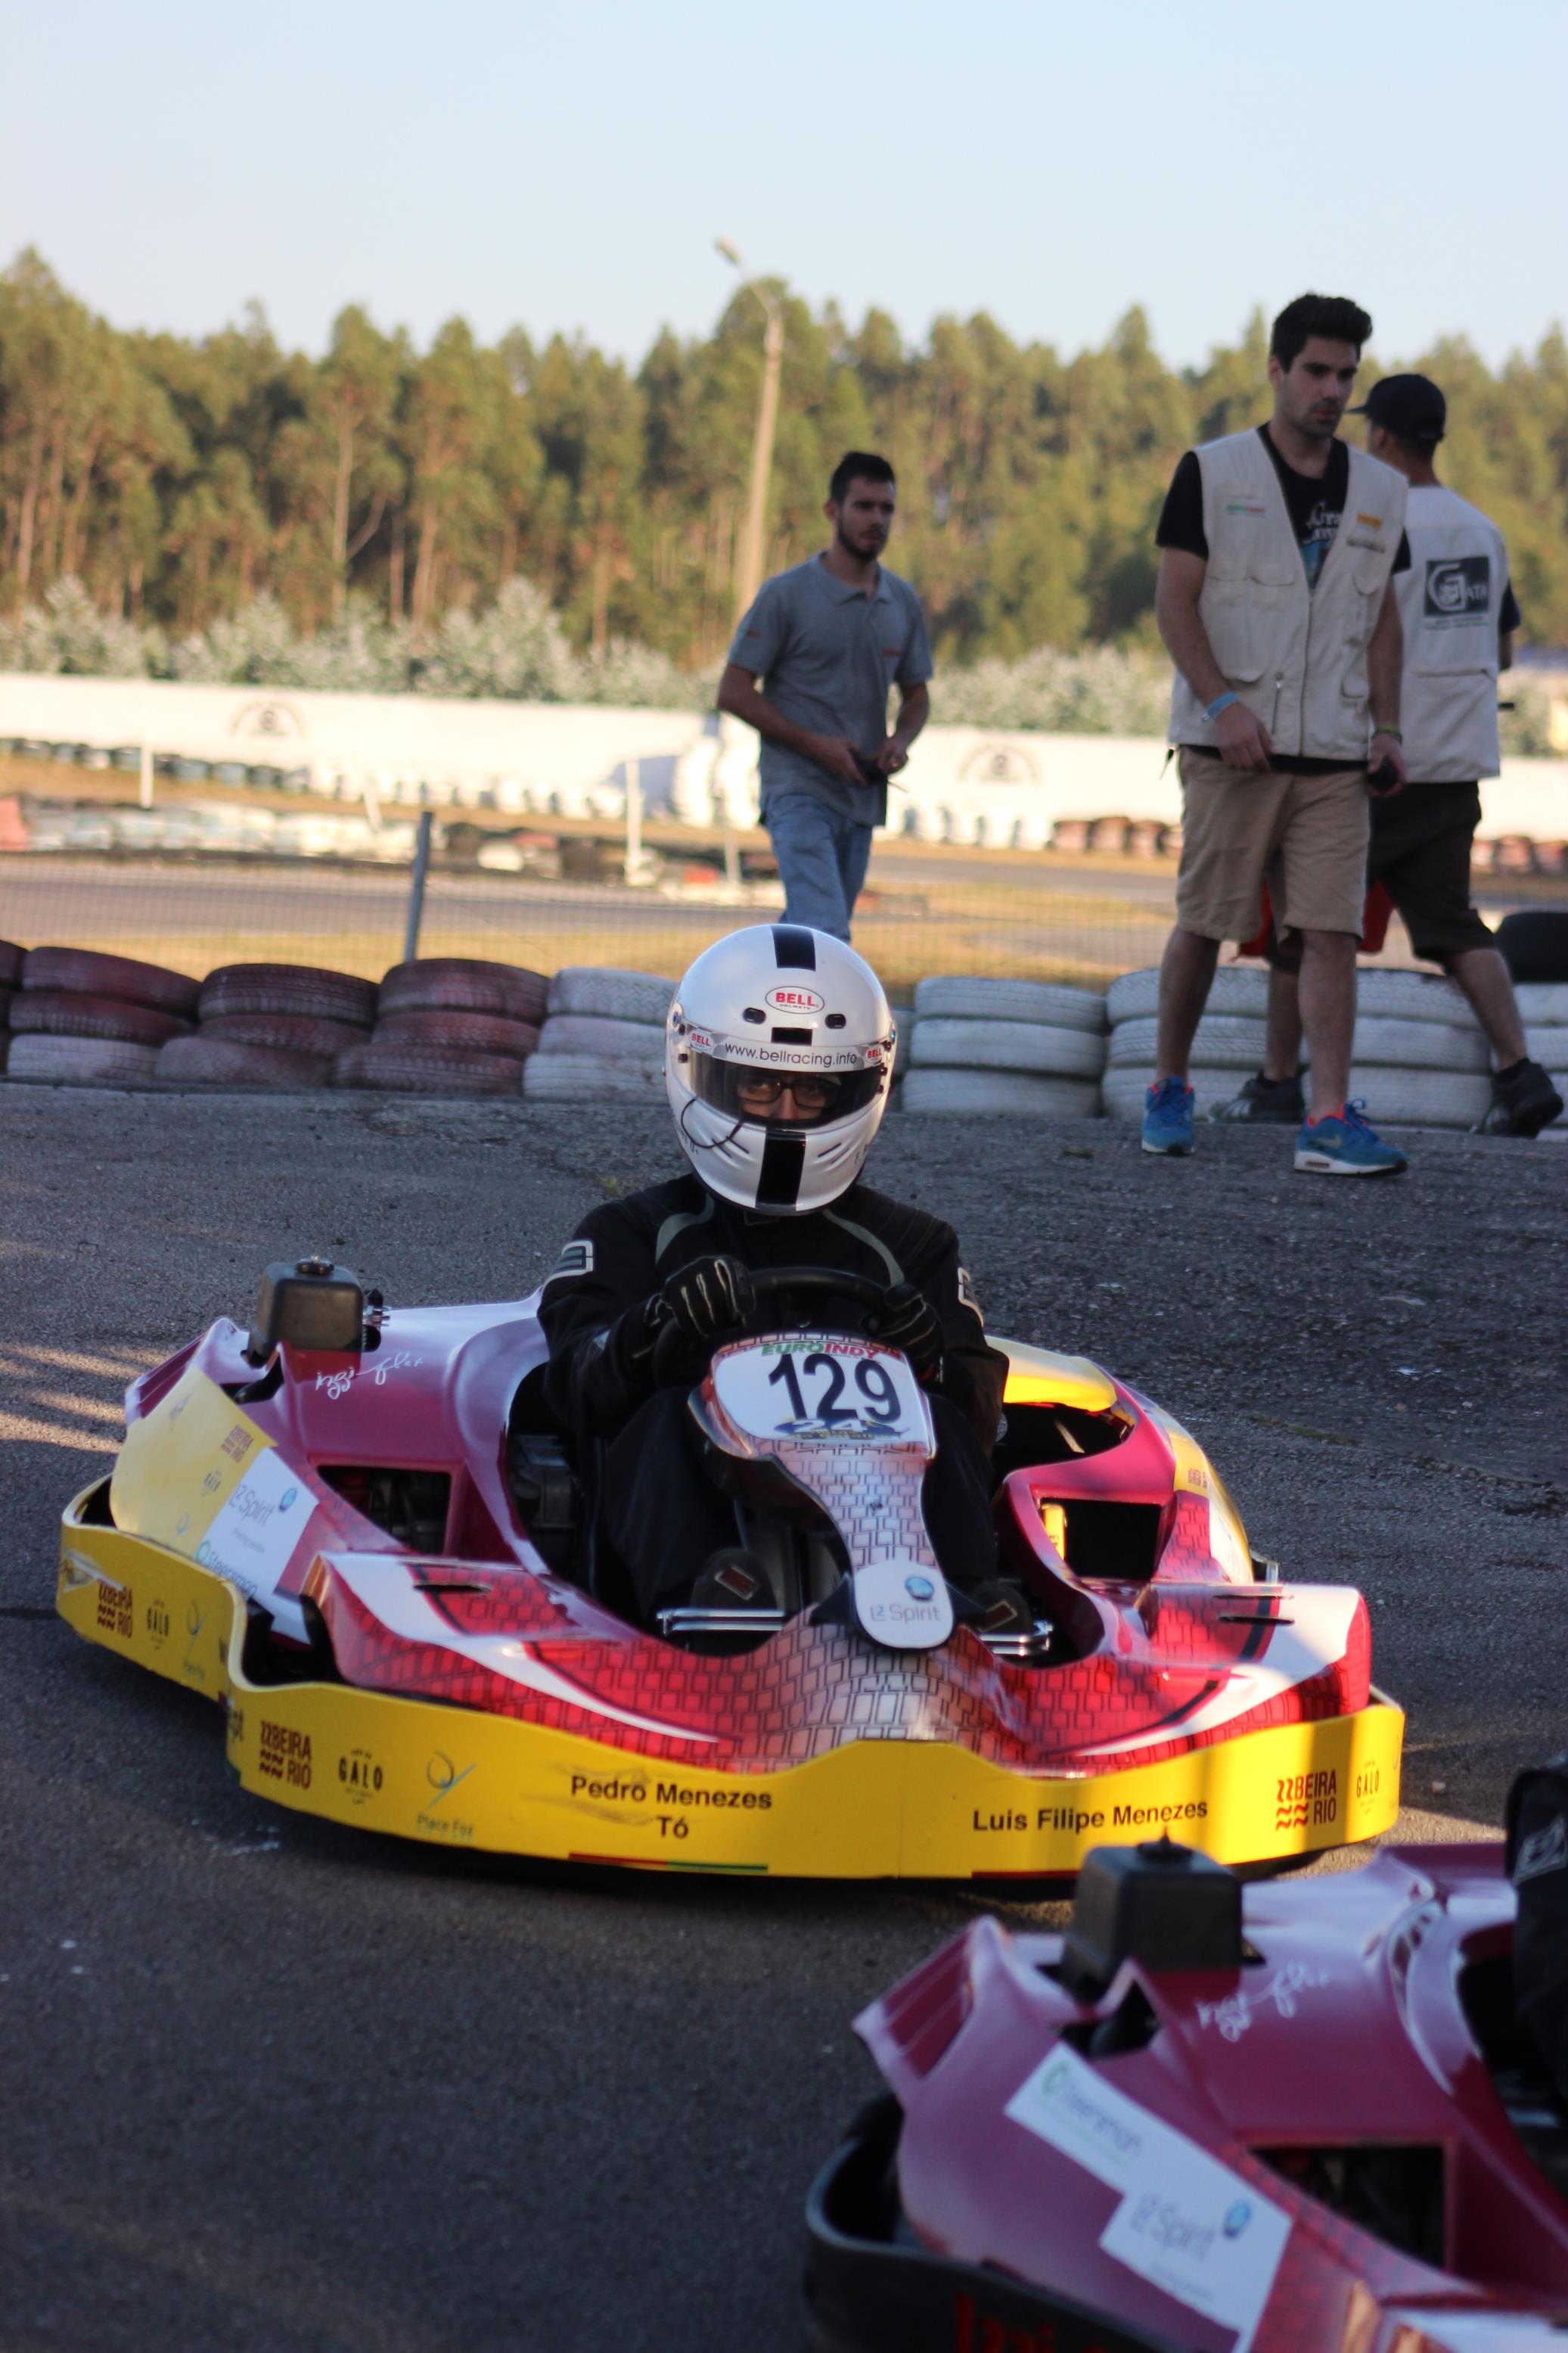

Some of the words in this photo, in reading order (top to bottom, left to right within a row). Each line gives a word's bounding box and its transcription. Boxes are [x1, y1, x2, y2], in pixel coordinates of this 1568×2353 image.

[775, 992, 815, 1007] BELL
[691, 1033, 710, 1046] BELL
[868, 1049, 881, 1058] BELL
[725, 1043, 857, 1068] www.bellracing.info
[768, 1353, 901, 1423] 129
[889, 1603, 942, 1625] Spirit
[287, 1761, 312, 1790] RIO
[338, 1758, 383, 1791] GALO
[1294, 1769, 1337, 1800] BEIRA
[1356, 1769, 1380, 1798] GALO
[571, 1775, 646, 1802] Pedro
[656, 1783, 772, 1810] Menezes
[973, 1809, 1028, 1832] Luis
[1037, 1808, 1104, 1835] Filipe
[1113, 1801, 1208, 1826] Menezes
[1313, 1798, 1337, 1825] RIO
[656, 1815, 690, 1839] Tó
